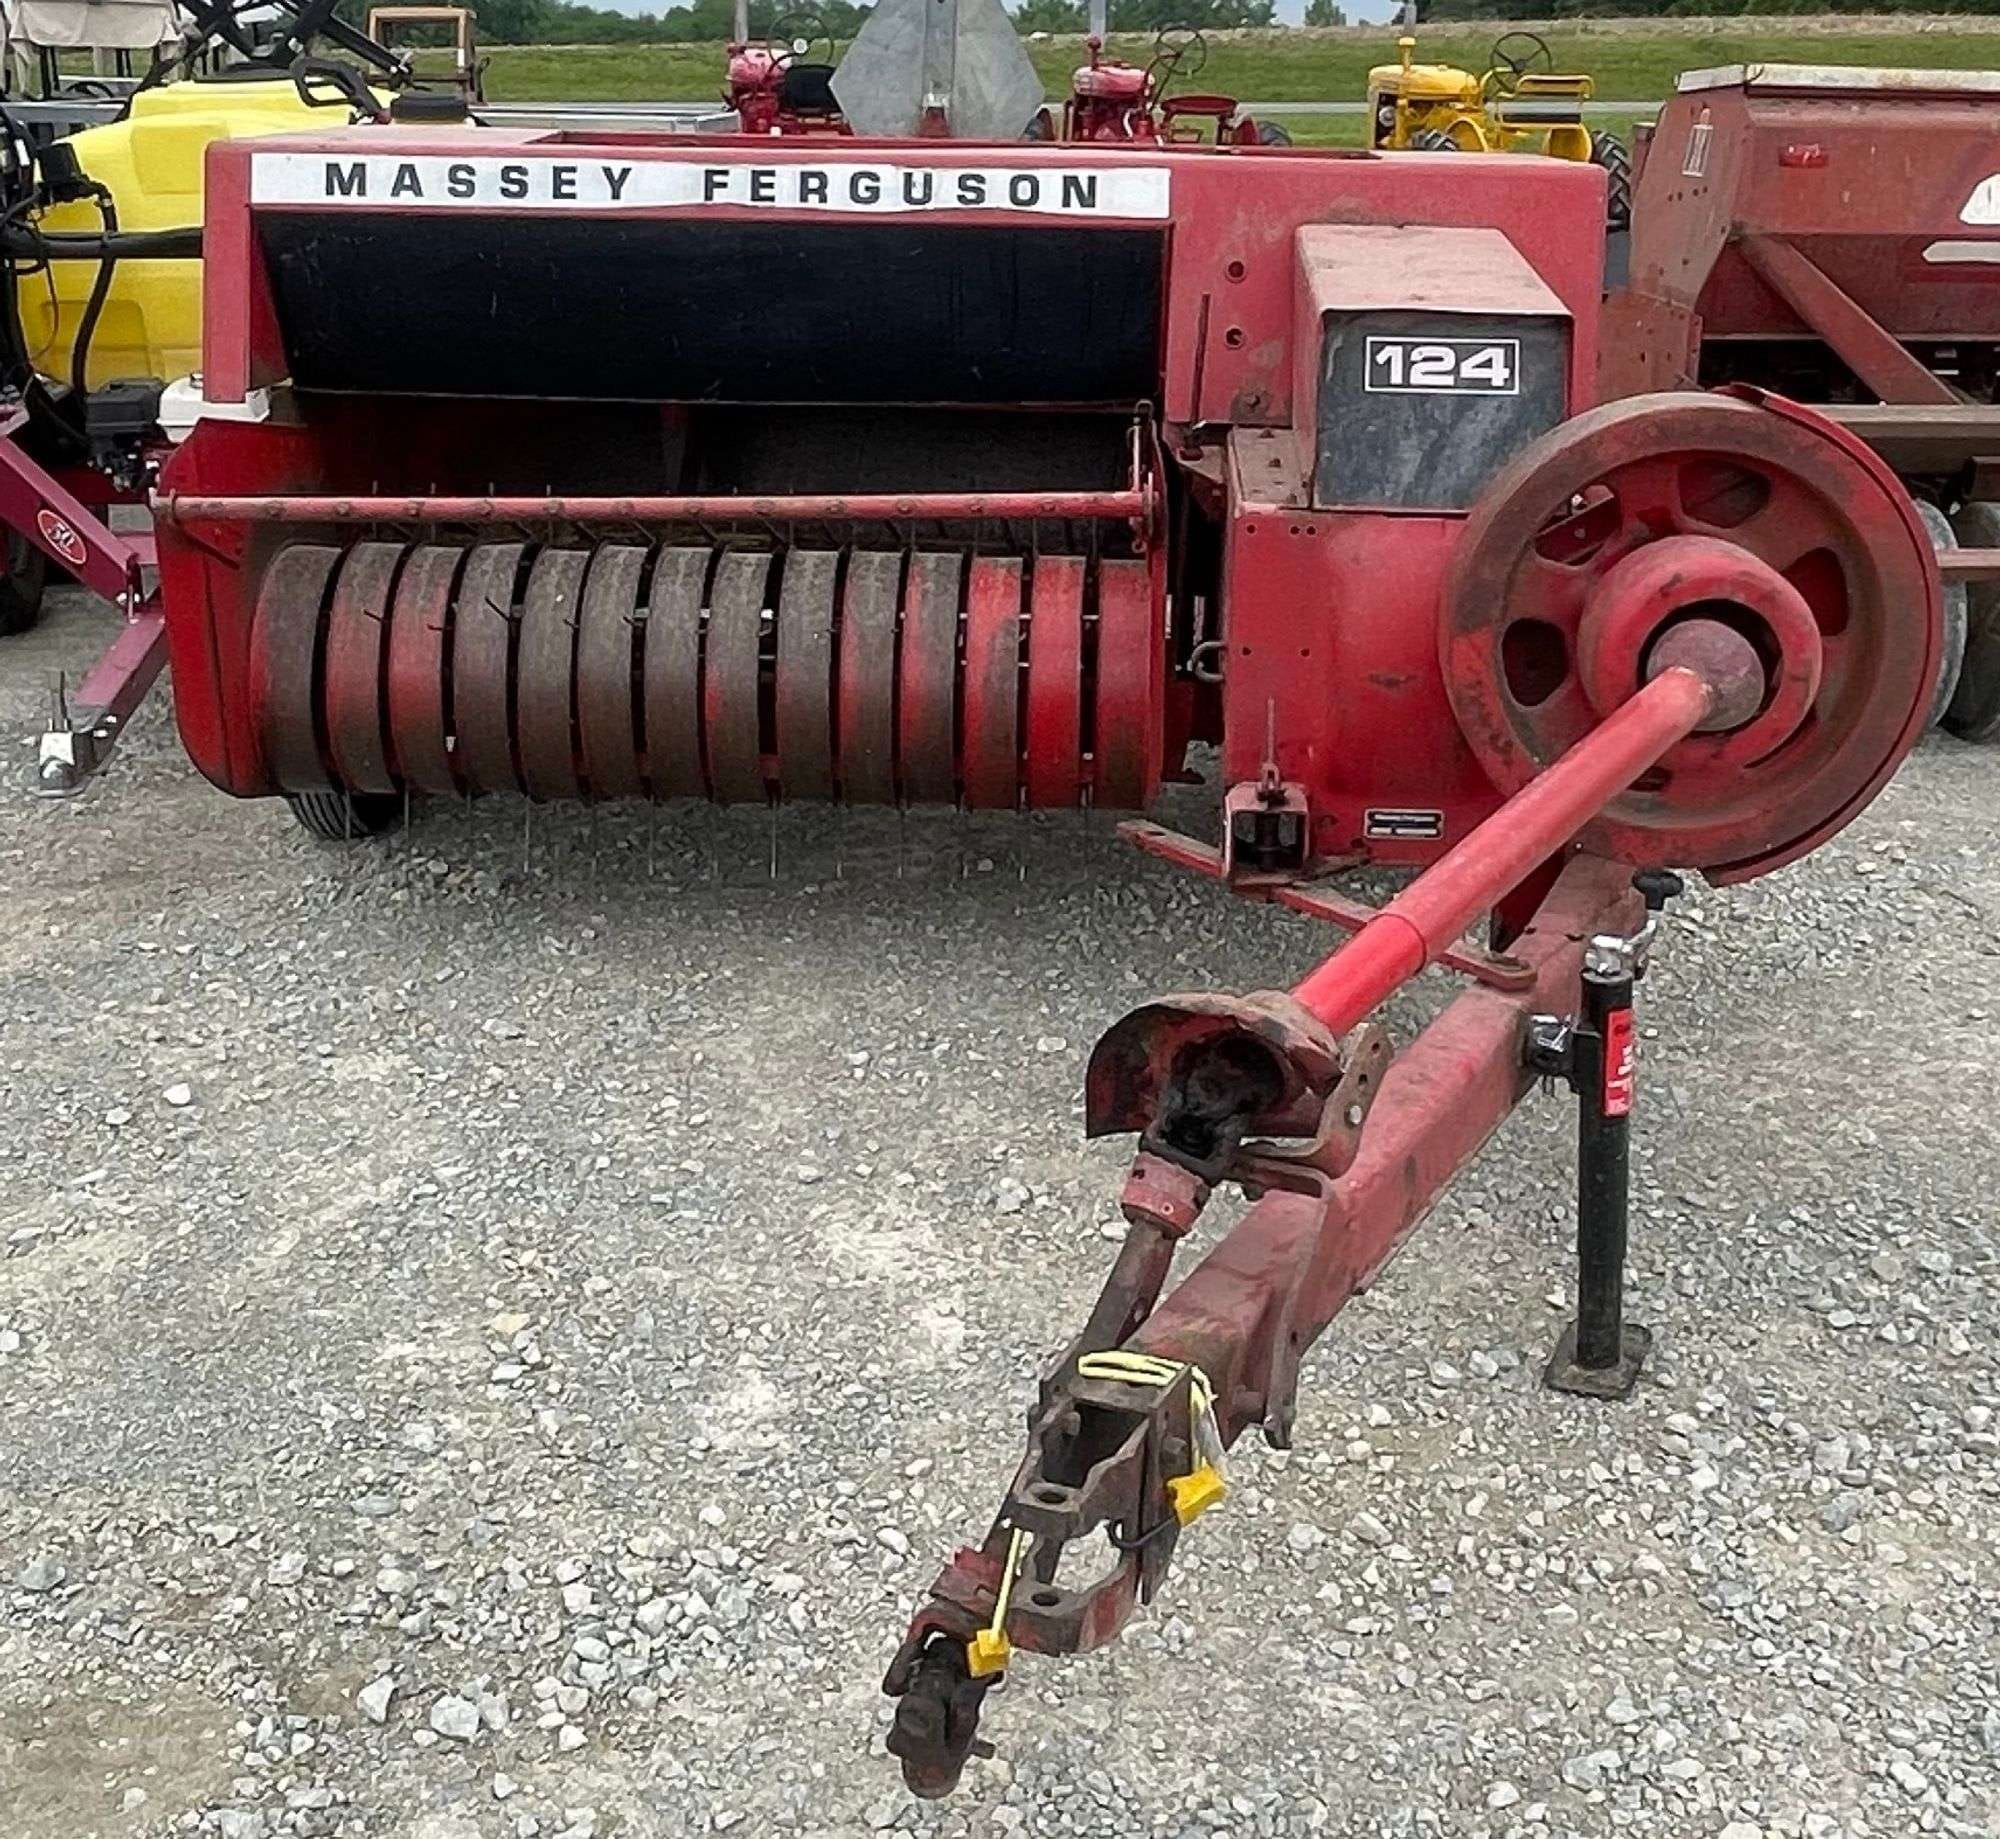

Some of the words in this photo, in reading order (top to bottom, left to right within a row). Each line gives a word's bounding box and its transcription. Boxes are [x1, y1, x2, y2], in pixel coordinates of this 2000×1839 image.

[325, 162, 633, 200] MASSEY
[703, 168, 1098, 209] FERGUSON
[1375, 345, 1510, 386] 124
